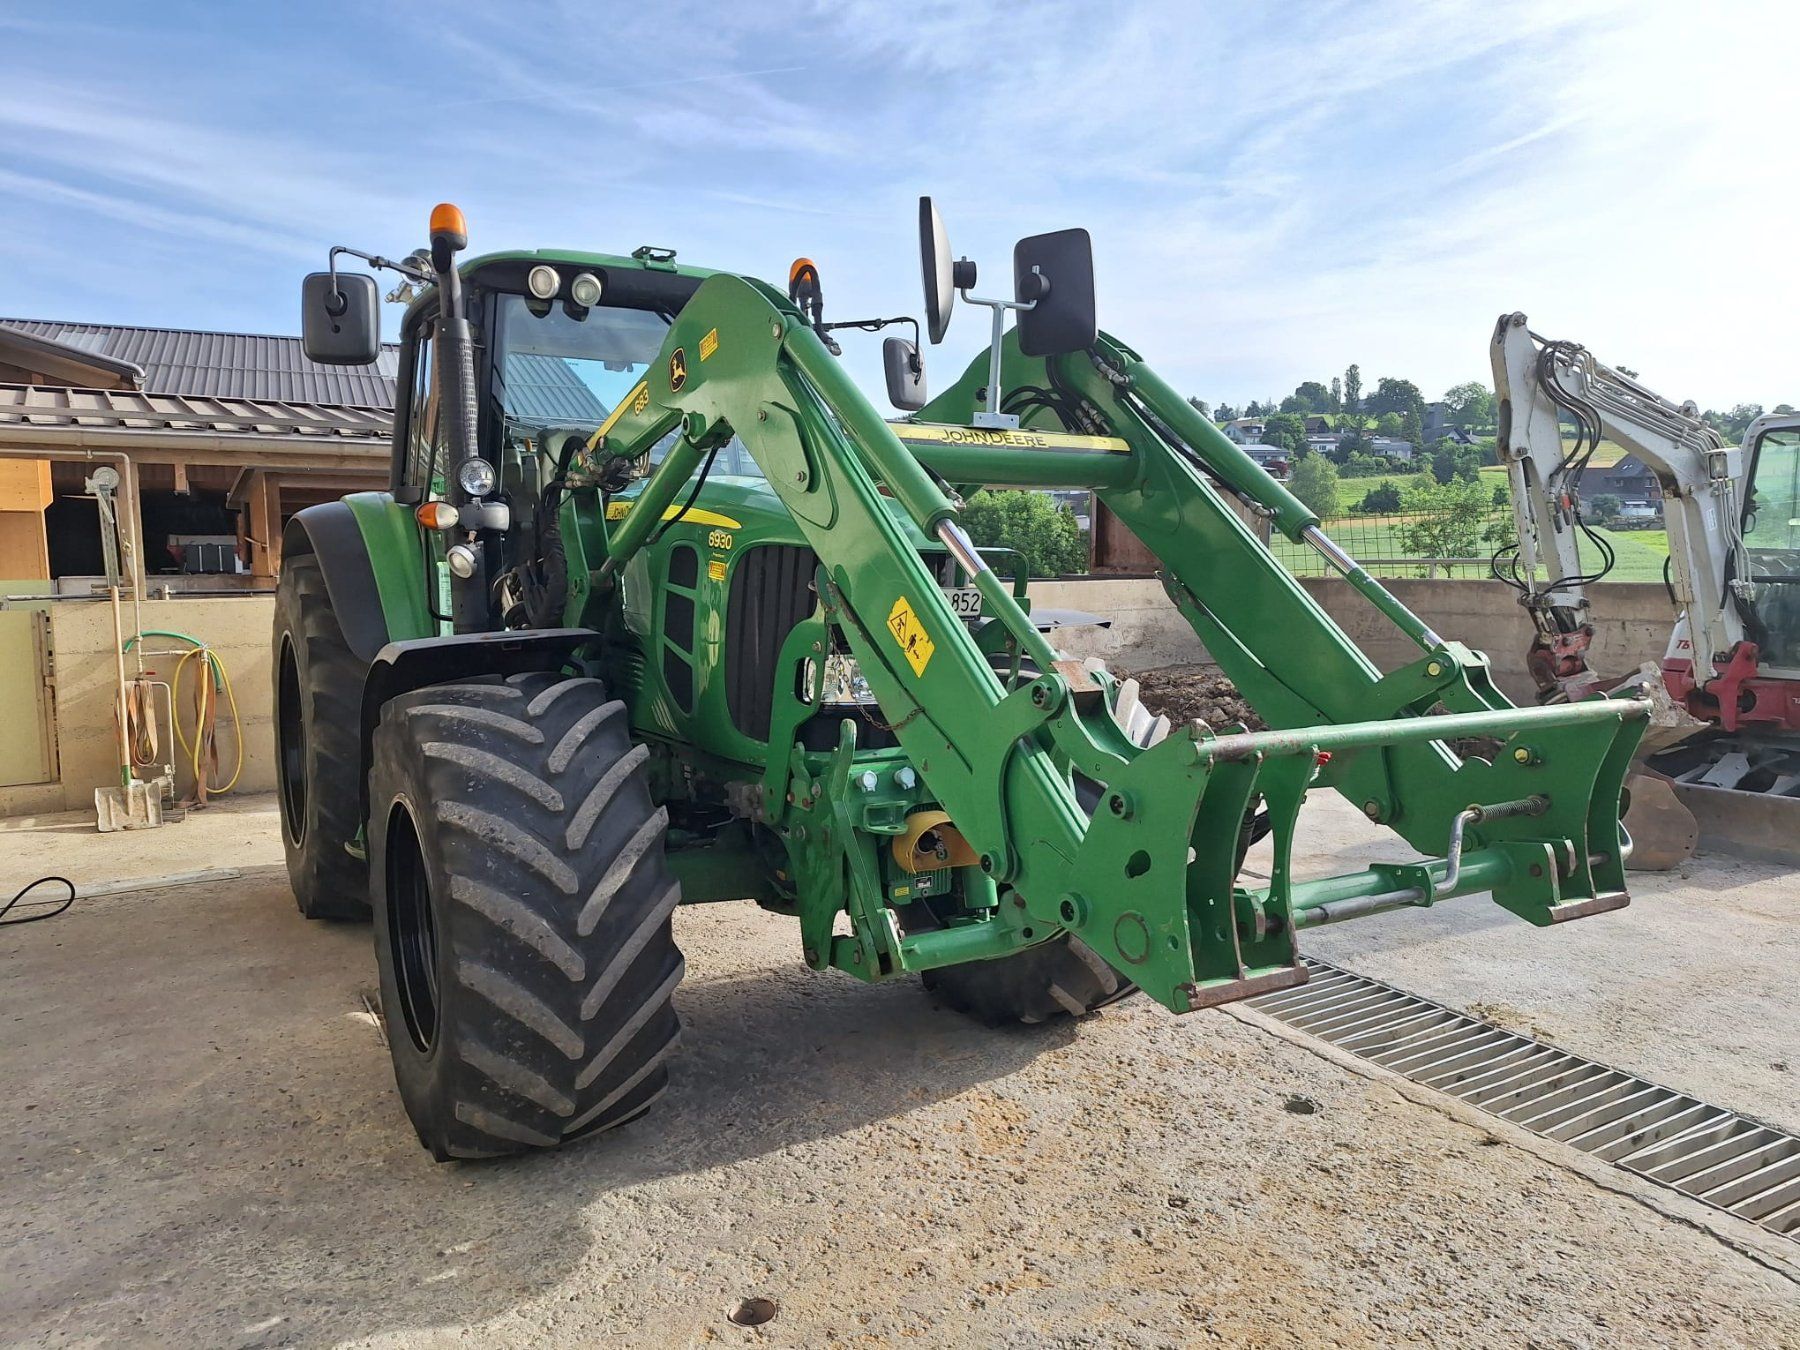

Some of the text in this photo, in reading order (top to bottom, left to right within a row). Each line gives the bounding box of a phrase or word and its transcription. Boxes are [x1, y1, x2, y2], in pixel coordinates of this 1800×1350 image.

[635, 389, 649, 415] 683
[942, 429, 1047, 446] JOHN DEERE
[708, 531, 732, 550] 6930
[945, 592, 980, 612] 852
